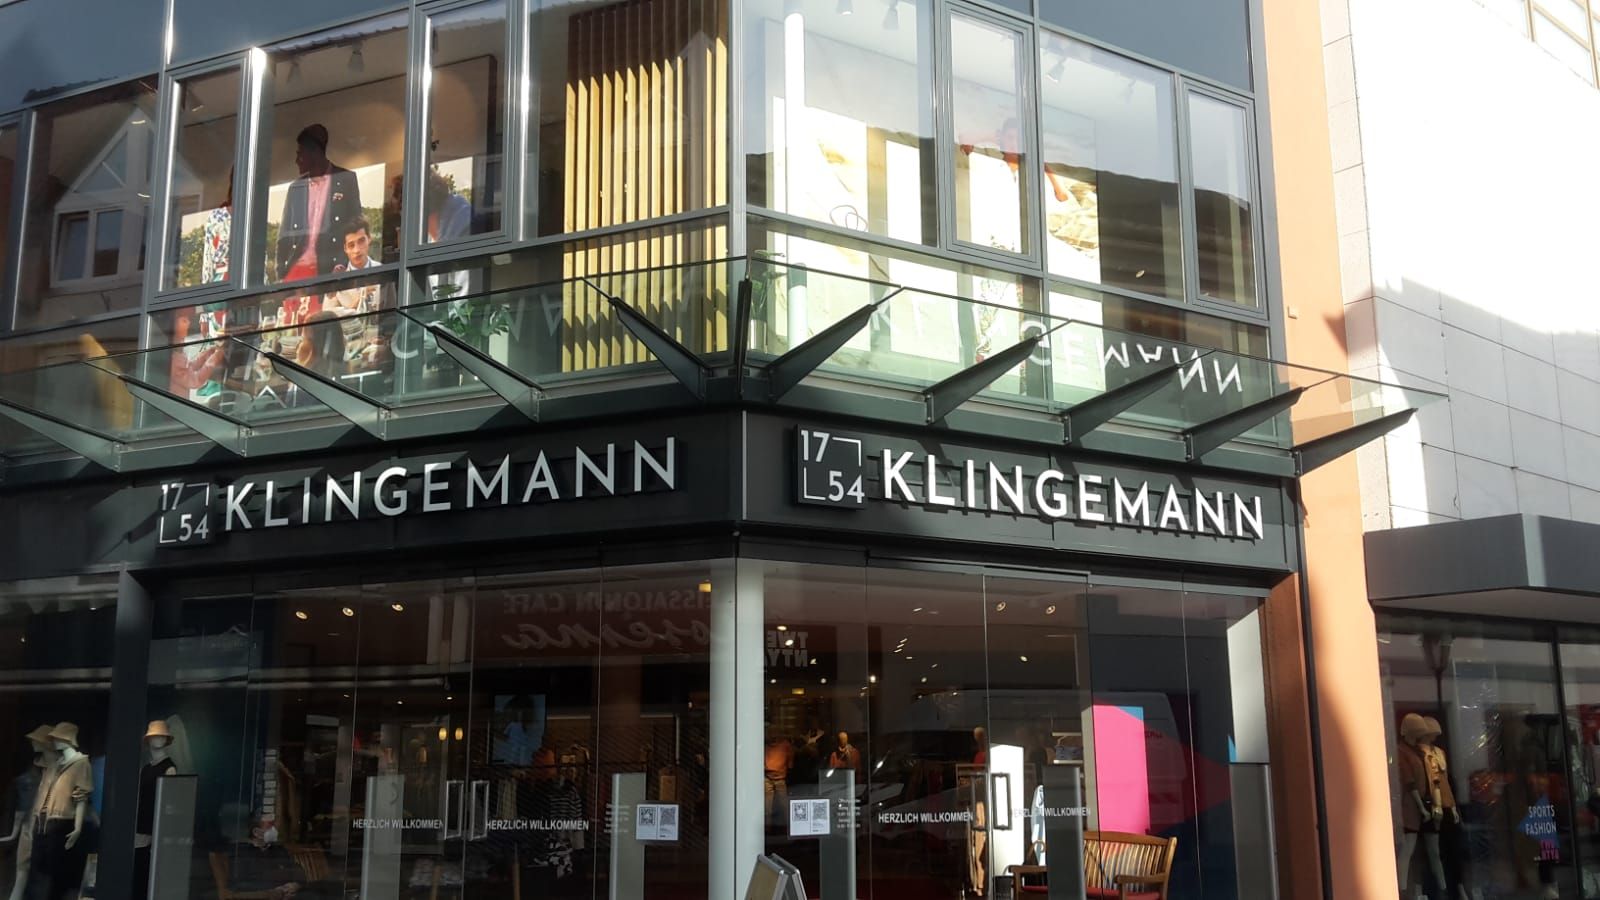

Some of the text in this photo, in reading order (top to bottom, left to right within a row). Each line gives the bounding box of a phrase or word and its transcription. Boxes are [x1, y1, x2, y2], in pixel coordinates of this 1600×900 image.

[801, 429, 830, 463] 17
[160, 482, 184, 510] 17
[225, 436, 677, 531] KLINGEMANN
[829, 471, 865, 503] 54
[881, 448, 1265, 540] KLINGEMANN
[178, 513, 209, 540] 54
[353, 818, 390, 829] HERZLICH
[878, 811, 919, 824] HERZLICH
[920, 809, 974, 823] WILLKOMMEN
[1528, 805, 1555, 817] SPORTS
[485, 819, 589, 831] HERZLICH WILLKOMMEN
[1525, 821, 1556, 835] FASHION
